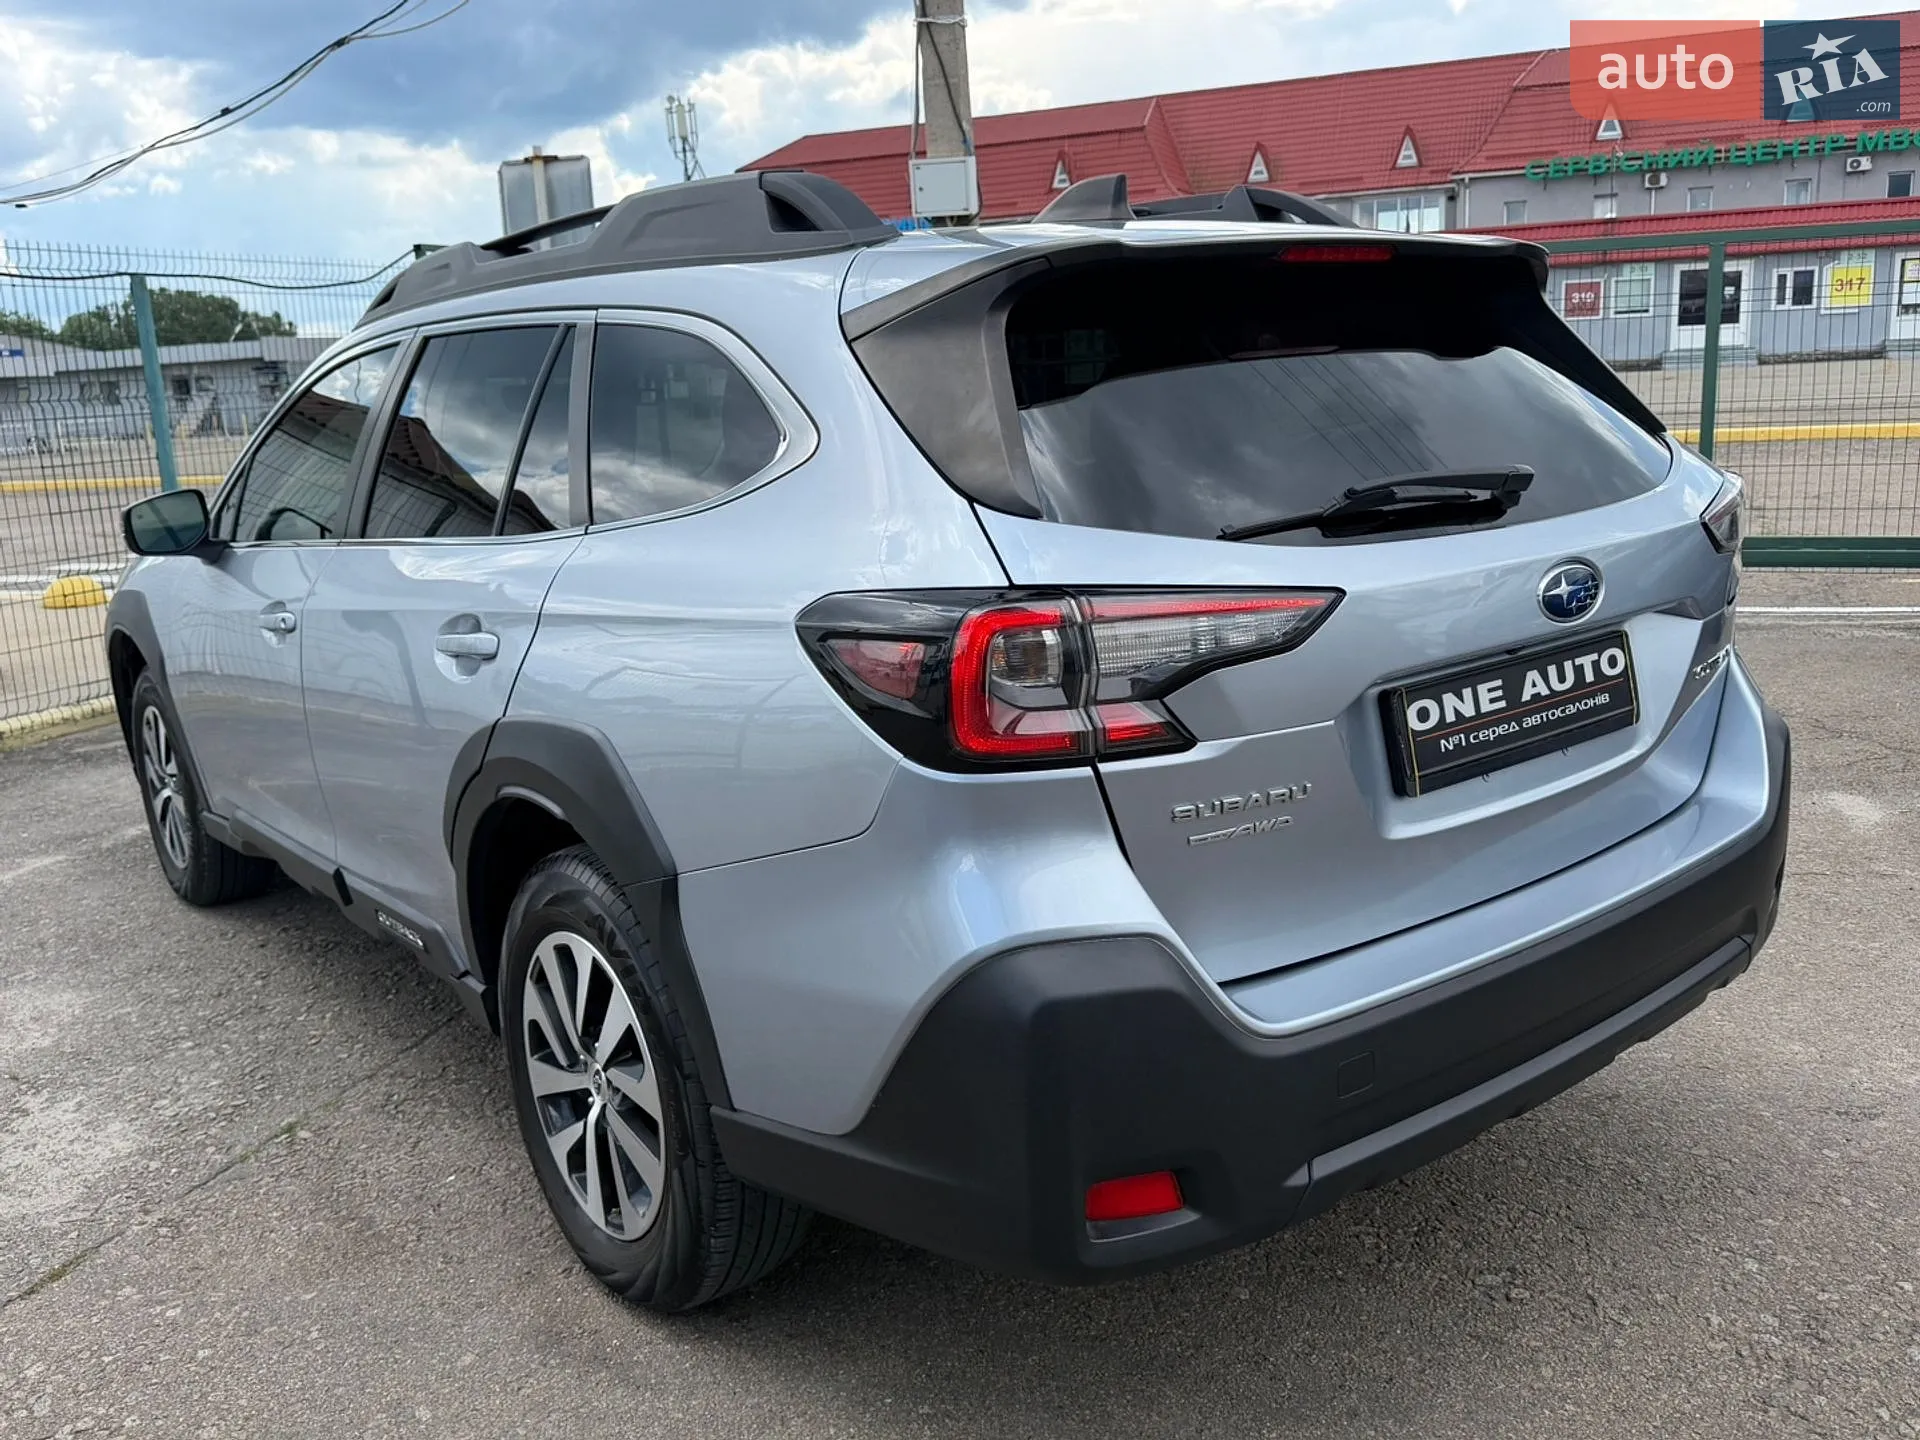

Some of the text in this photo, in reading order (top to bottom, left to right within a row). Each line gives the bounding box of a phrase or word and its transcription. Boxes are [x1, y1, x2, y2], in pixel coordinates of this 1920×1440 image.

[1729, 133, 1846, 166] ЦЕНТР
[1834, 277, 1865, 292] 317
[1407, 647, 1626, 731] ONE AUTO
[1440, 692, 1610, 752] №1 серед автосалонів
[1171, 782, 1312, 822] SUBARU
[1228, 815, 1295, 840] AWD
